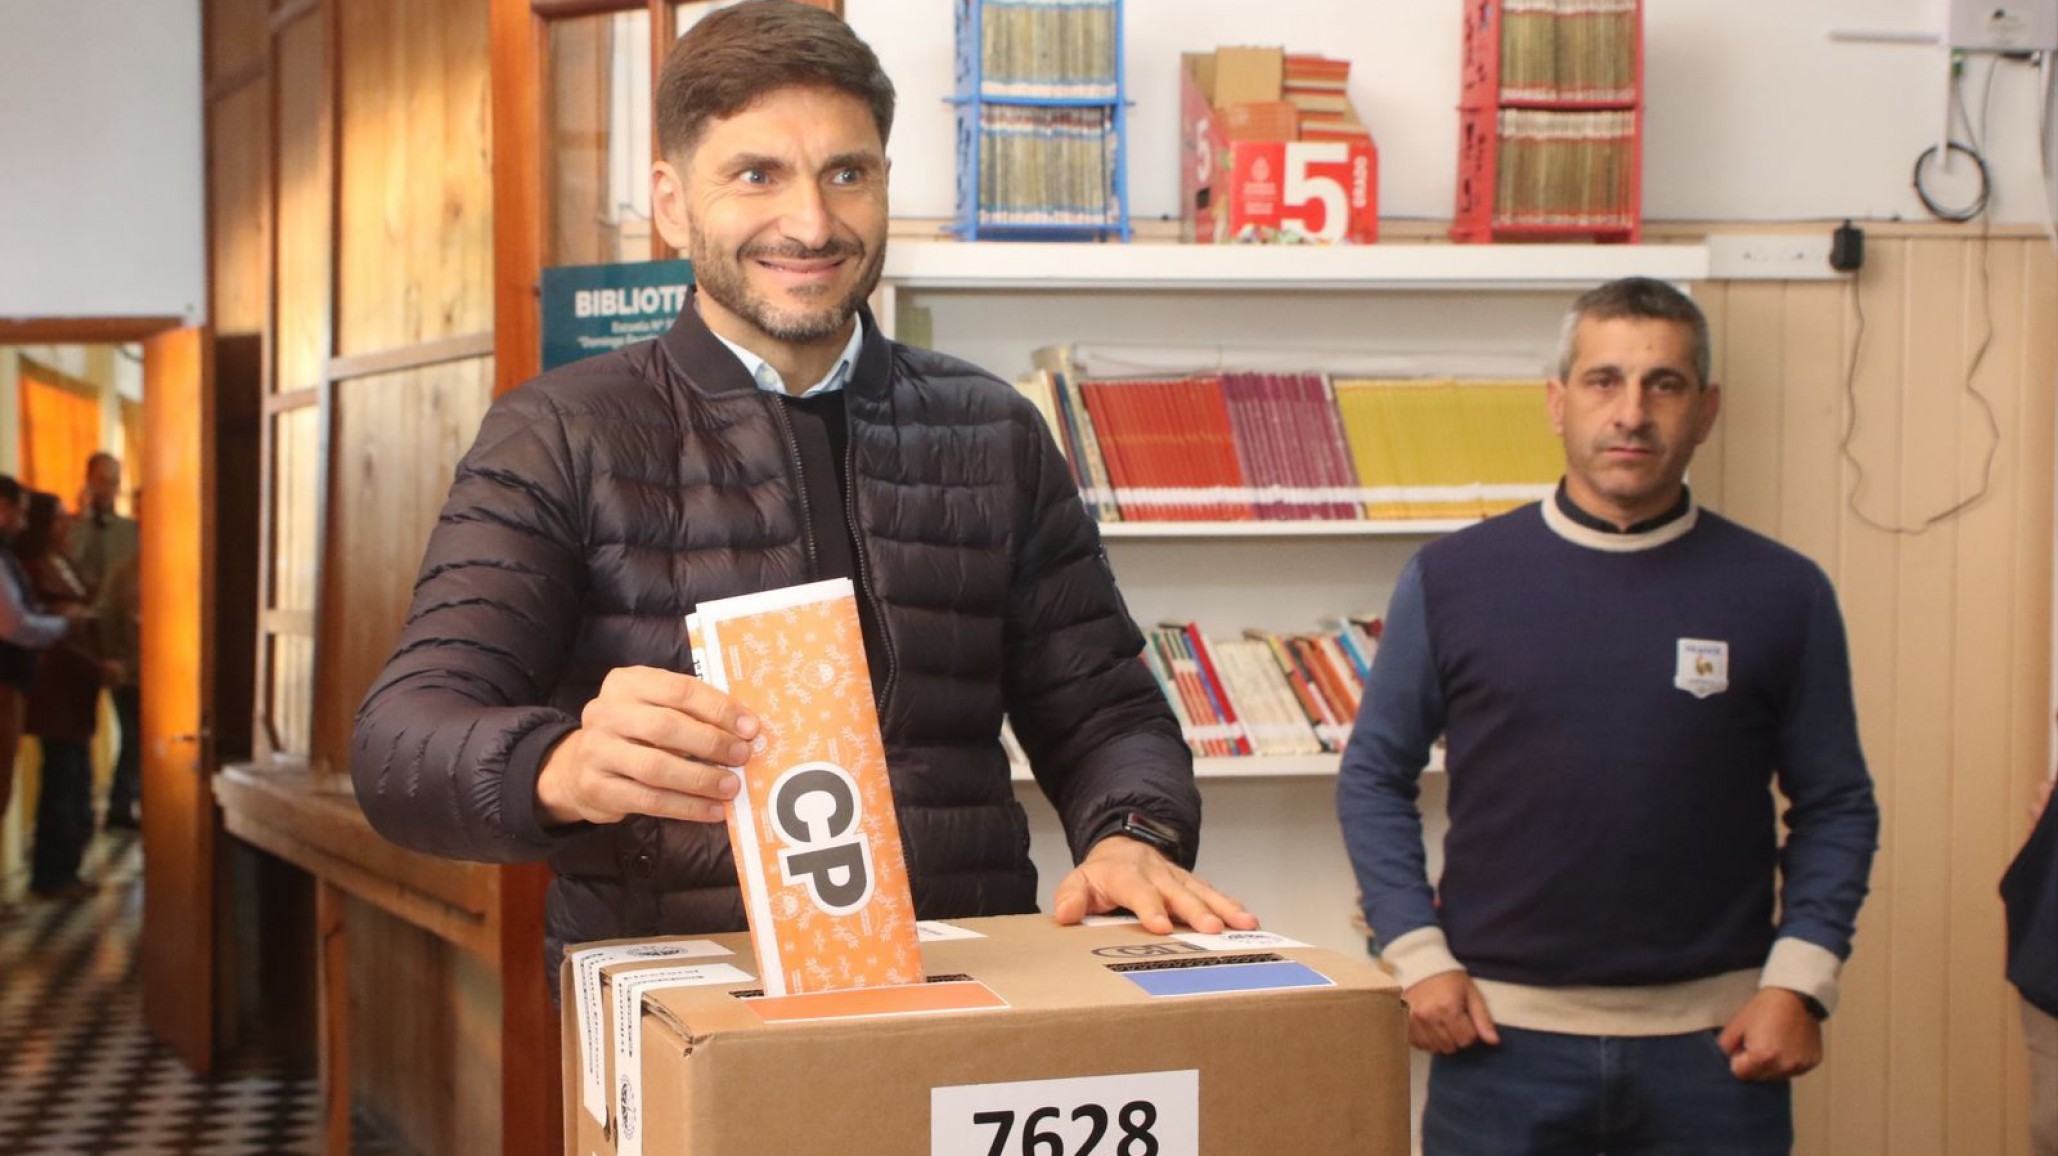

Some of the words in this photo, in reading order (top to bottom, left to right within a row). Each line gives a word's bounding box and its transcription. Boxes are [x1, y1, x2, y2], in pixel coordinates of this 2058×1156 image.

[1196, 120, 1211, 181] 5
[1281, 142, 1349, 243] 5
[1353, 156, 1368, 208] GRADO
[776, 769, 868, 907] CP
[973, 1100, 1159, 1156] 7628
